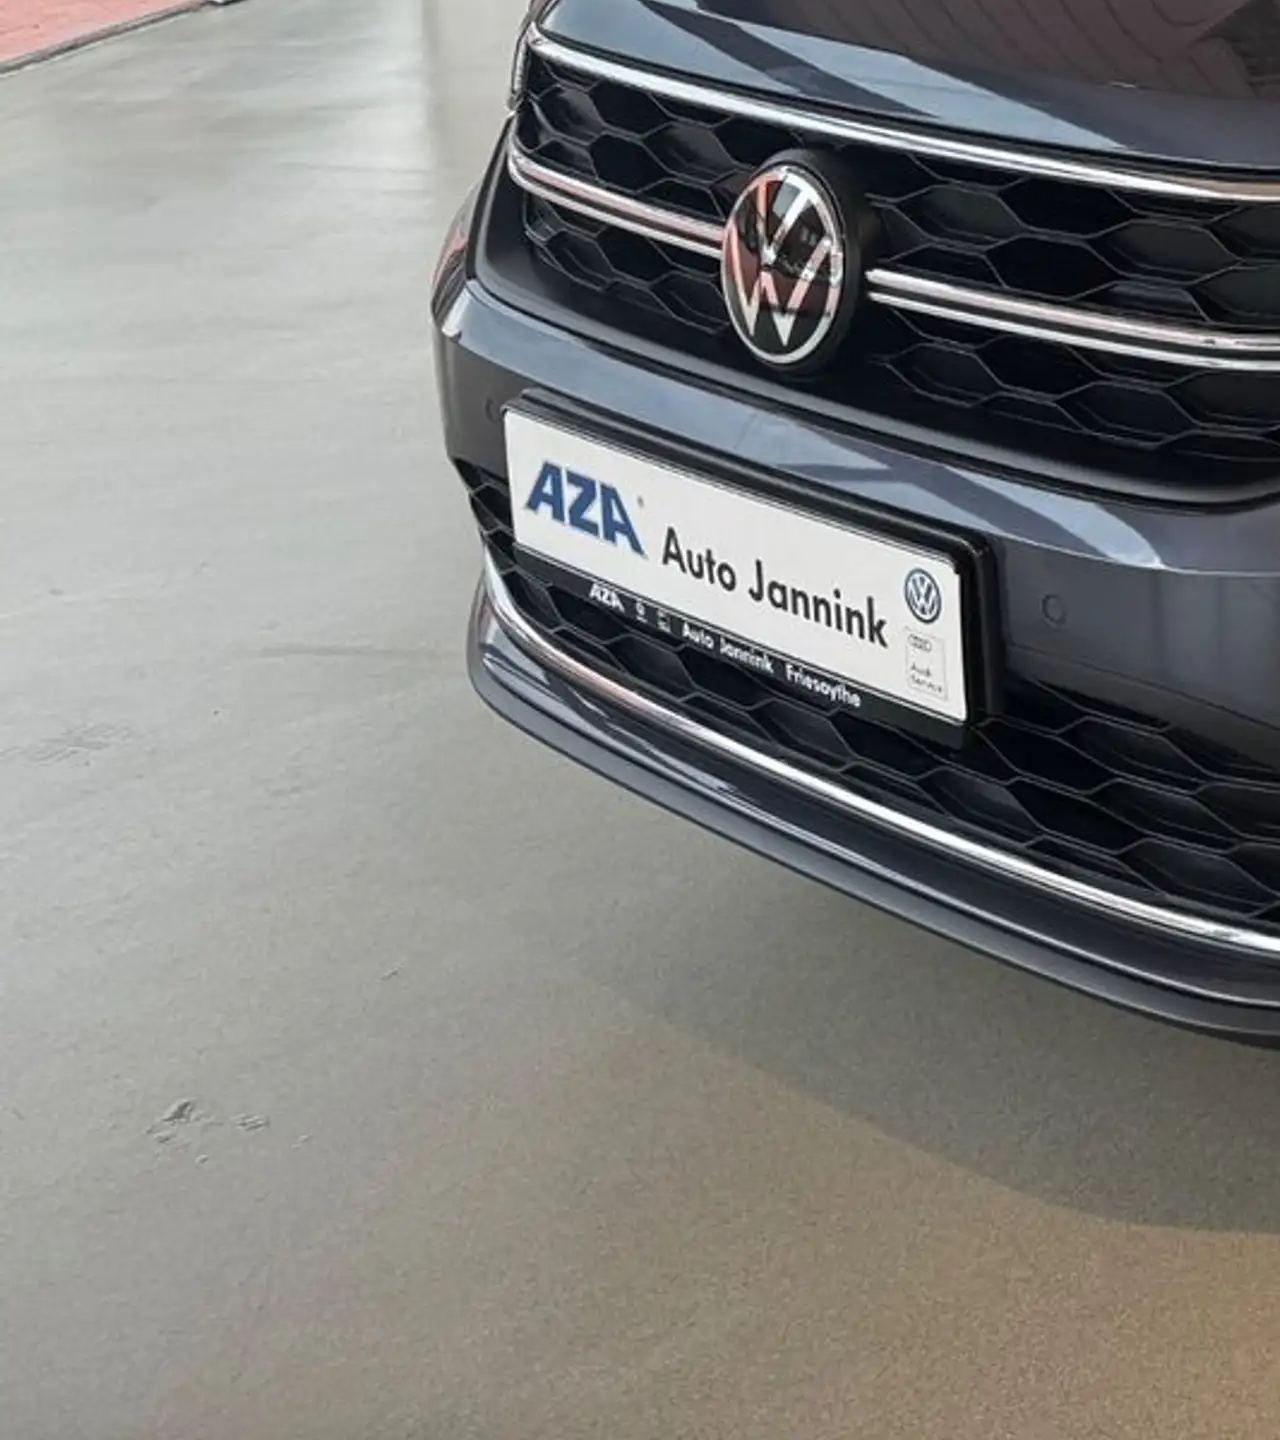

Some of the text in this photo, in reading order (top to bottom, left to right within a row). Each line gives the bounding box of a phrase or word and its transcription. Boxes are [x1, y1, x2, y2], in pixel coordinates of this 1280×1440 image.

[525, 460, 648, 560] AZA
[661, 526, 889, 649] Auto Jannink
